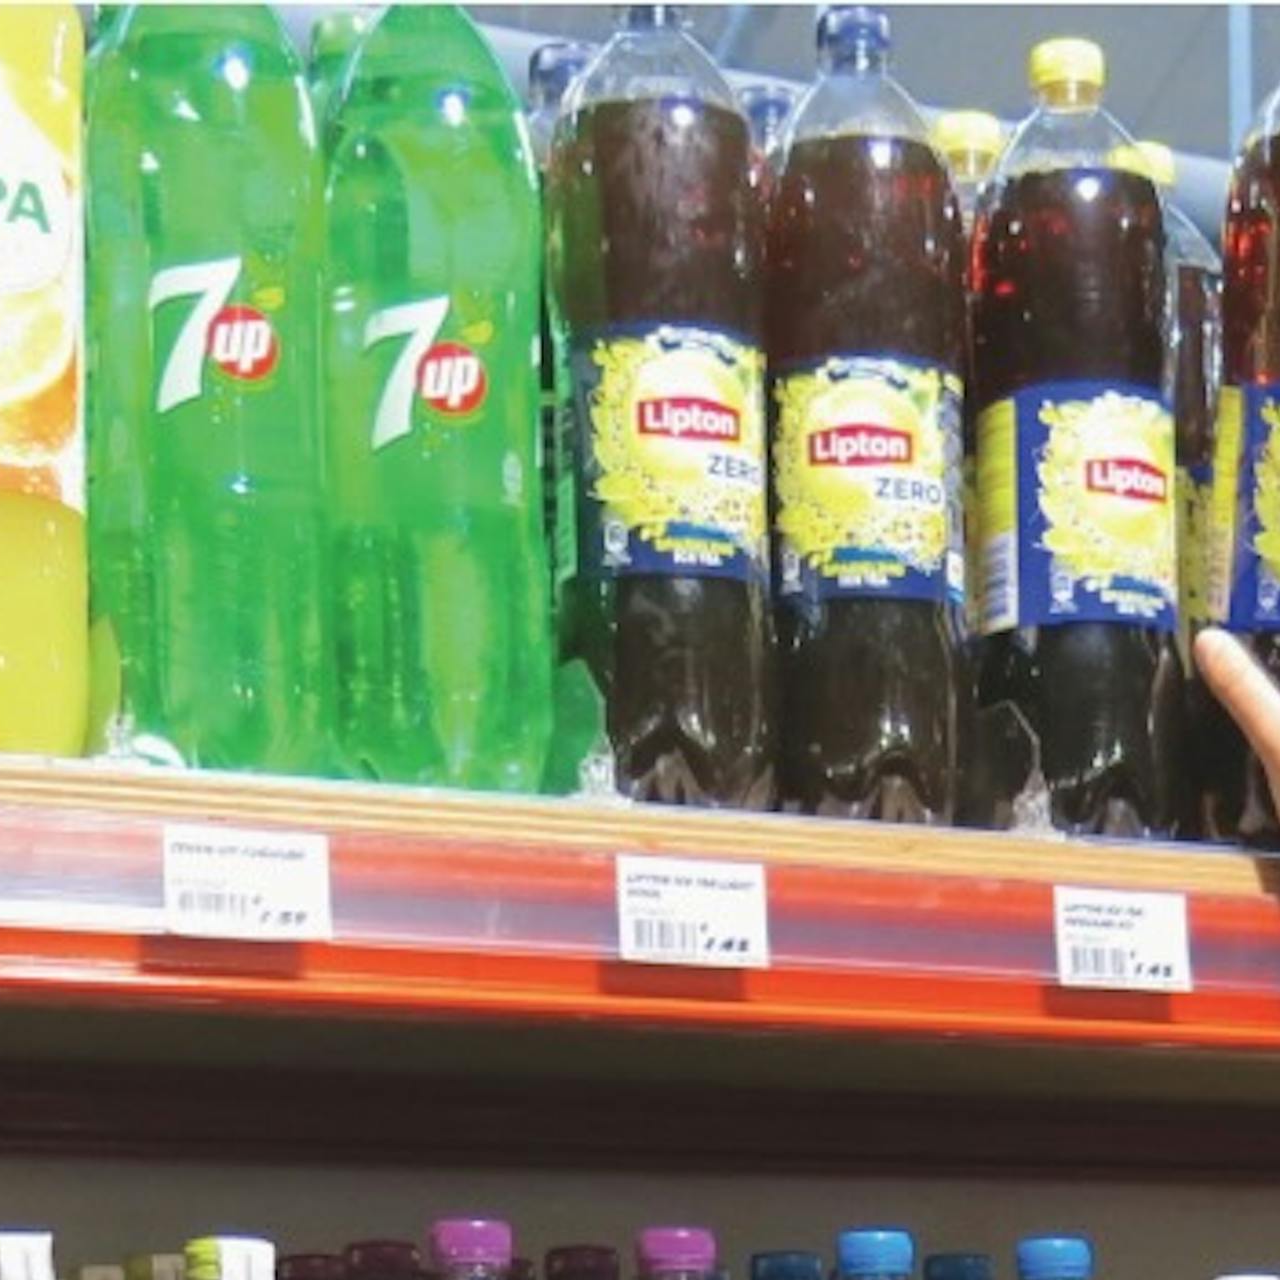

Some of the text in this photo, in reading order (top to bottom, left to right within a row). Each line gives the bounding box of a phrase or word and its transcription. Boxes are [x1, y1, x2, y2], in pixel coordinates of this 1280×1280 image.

[643, 402, 738, 437] Lipton
[815, 429, 908, 462] Lipton
[875, 478, 941, 502] ZERO
[1091, 460, 1166, 496] Lipton
